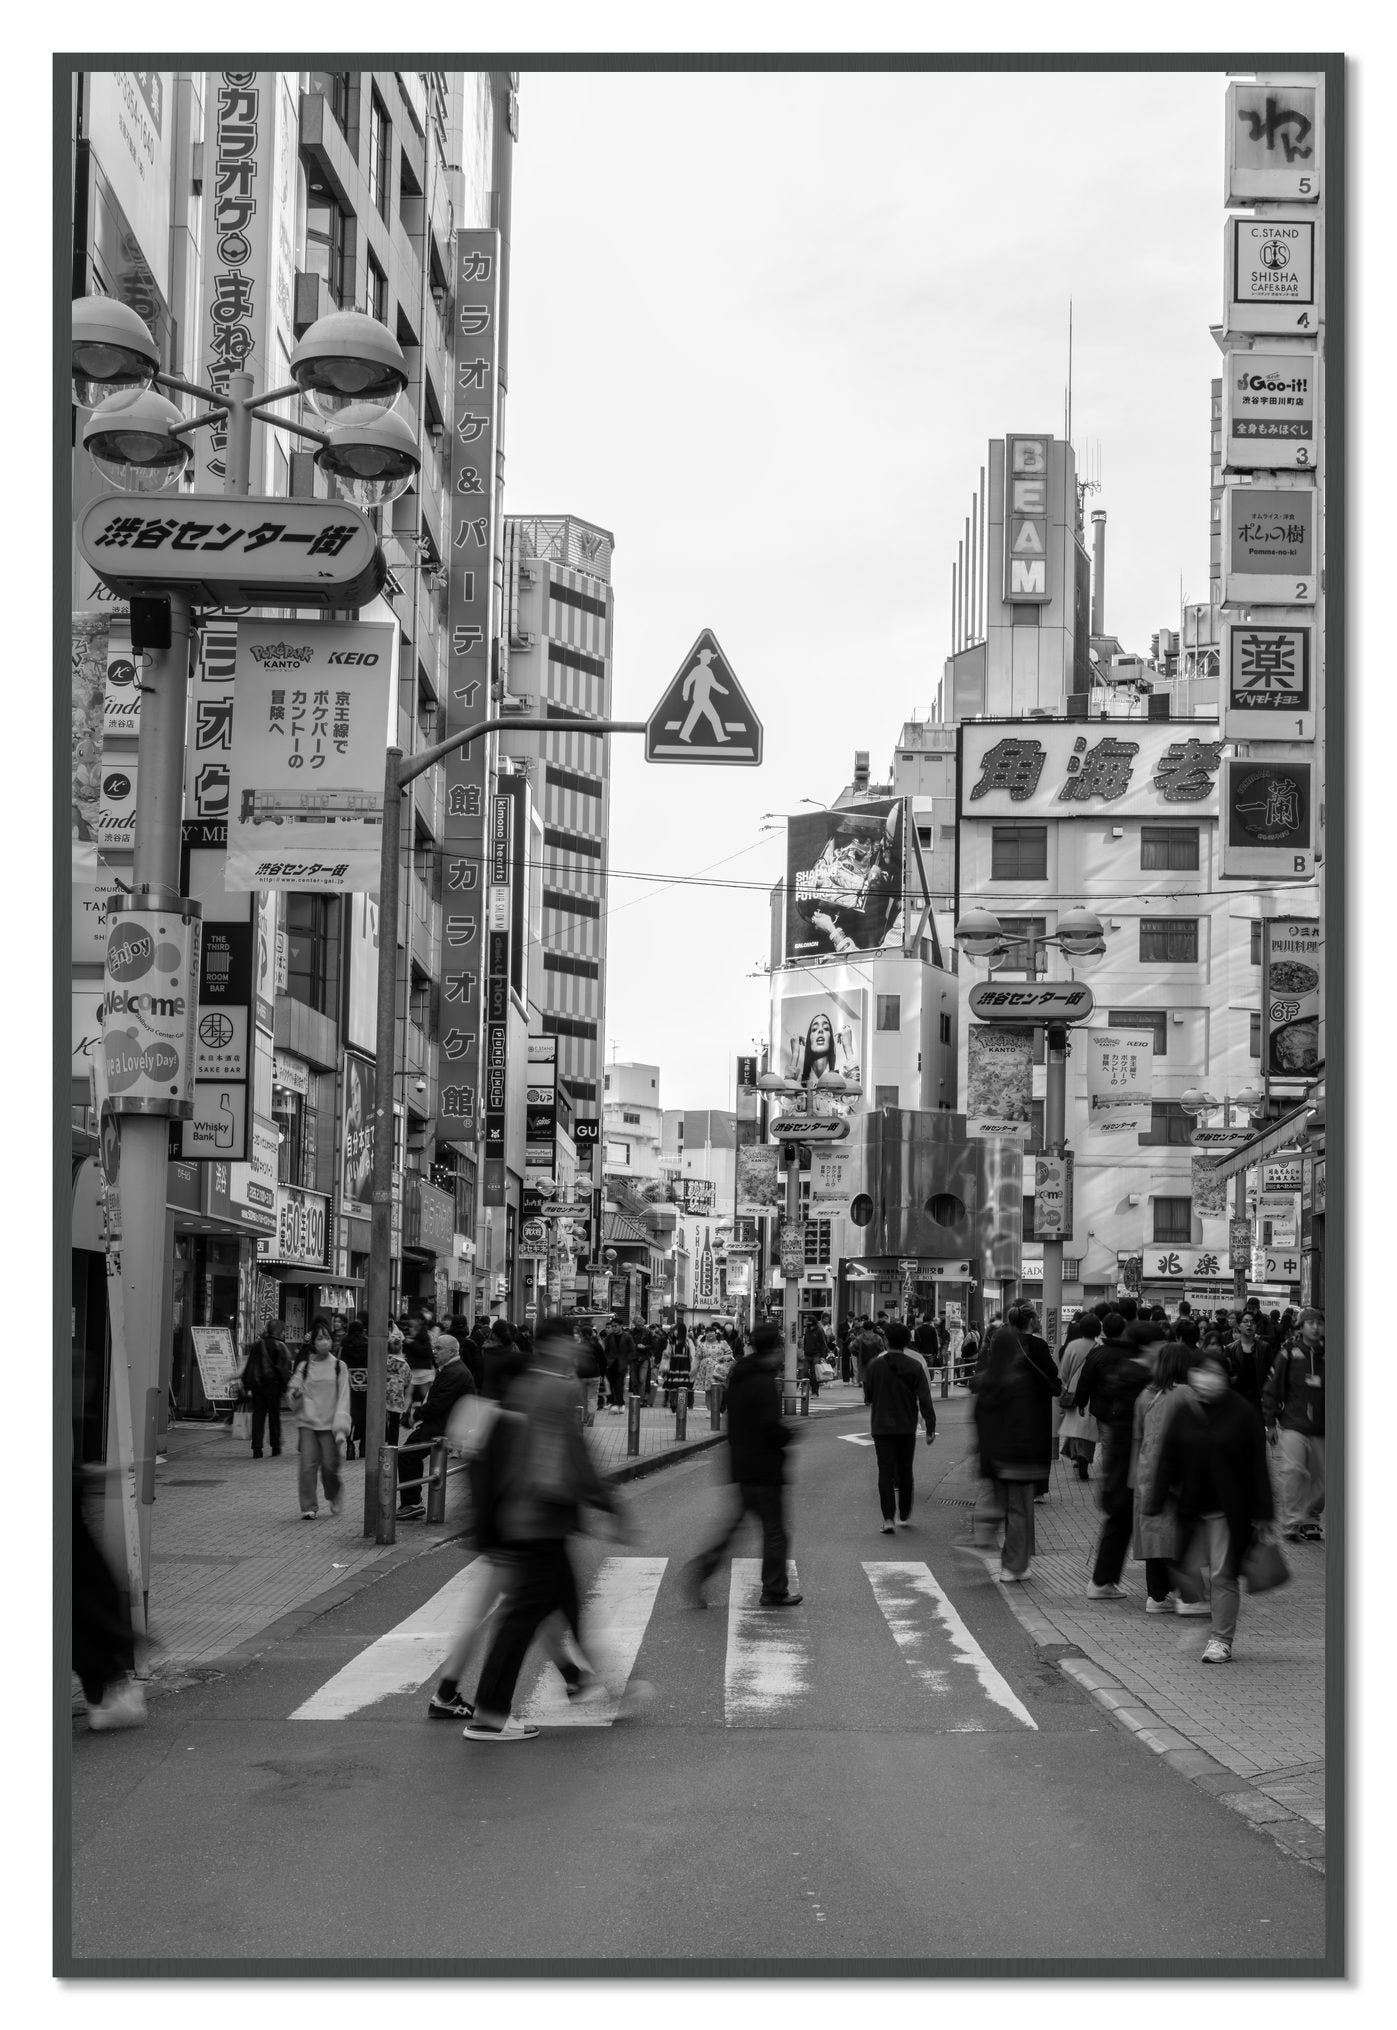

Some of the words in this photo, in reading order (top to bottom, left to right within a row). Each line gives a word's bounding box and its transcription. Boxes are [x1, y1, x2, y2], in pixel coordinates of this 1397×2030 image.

[214, 88, 259, 234] カラオケ
[1298, 178, 1311, 193] 5
[1251, 228, 1299, 238] C.STAND
[1251, 271, 1299, 282] SHISHA
[1251, 283, 1299, 292] CAFE&BAR
[1297, 312, 1310, 328] 4
[1242, 396, 1304, 406] 渋谷宇田川町店
[1237, 423, 1309, 435] 全身もみほぐし
[1296, 447, 1309, 465] 3
[1012, 440, 1046, 593] BEAM
[1251, 513, 1295, 521] オムライス・洋食
[94, 516, 359, 557] 渋谷センター街
[1238, 522, 1306, 544] ポムの樹
[1295, 583, 1308, 599] 2
[327, 652, 380, 666] KEIO
[1241, 634, 1295, 688] 薬
[1235, 692, 1301, 706] マツモトキヨシ
[269, 690, 286, 735] 冒険へ
[109, 720, 135, 728] 渋谷店
[288, 690, 307, 768] カントーの
[310, 690, 329, 769] ポケパーク
[333, 691, 351, 754] 京王線で
[1295, 720, 1304, 735] 1
[969, 737, 1222, 801] 角海老
[1236, 779, 1300, 830] 一蘭
[497, 801, 505, 838] kimono
[104, 833, 130, 842] 渋谷店
[255, 863, 350, 876] 渋谷センター街
[496, 843, 504, 880] hearts
[1294, 856, 1306, 872] B
[496, 889, 504, 901] HAIR
[496, 904, 504, 921] SALON
[109, 937, 150, 972] Enjoy
[206, 973, 229, 981] ROOM
[442, 860, 478, 1118] カラオケ館
[104, 989, 186, 1016] Welcome
[976, 991, 1086, 1006] 渋谷センター街
[1270, 1001, 1300, 1022] 6F
[135, 1013, 156, 1034] Shibuya
[122, 1052, 154, 1072] Lovely
[156, 1053, 177, 1068] Day!
[193, 1122, 229, 1134] Whisky
[577, 1126, 597, 1137] GU
[774, 1122, 840, 1132] 渋谷センター街
[193, 1131, 214, 1141] Bank
[286, 1203, 300, 1254] 50
[306, 1209, 323, 1258] 190
[1157, 1252, 1221, 1275] 兆楽
[703, 1251, 712, 1296] BEER
